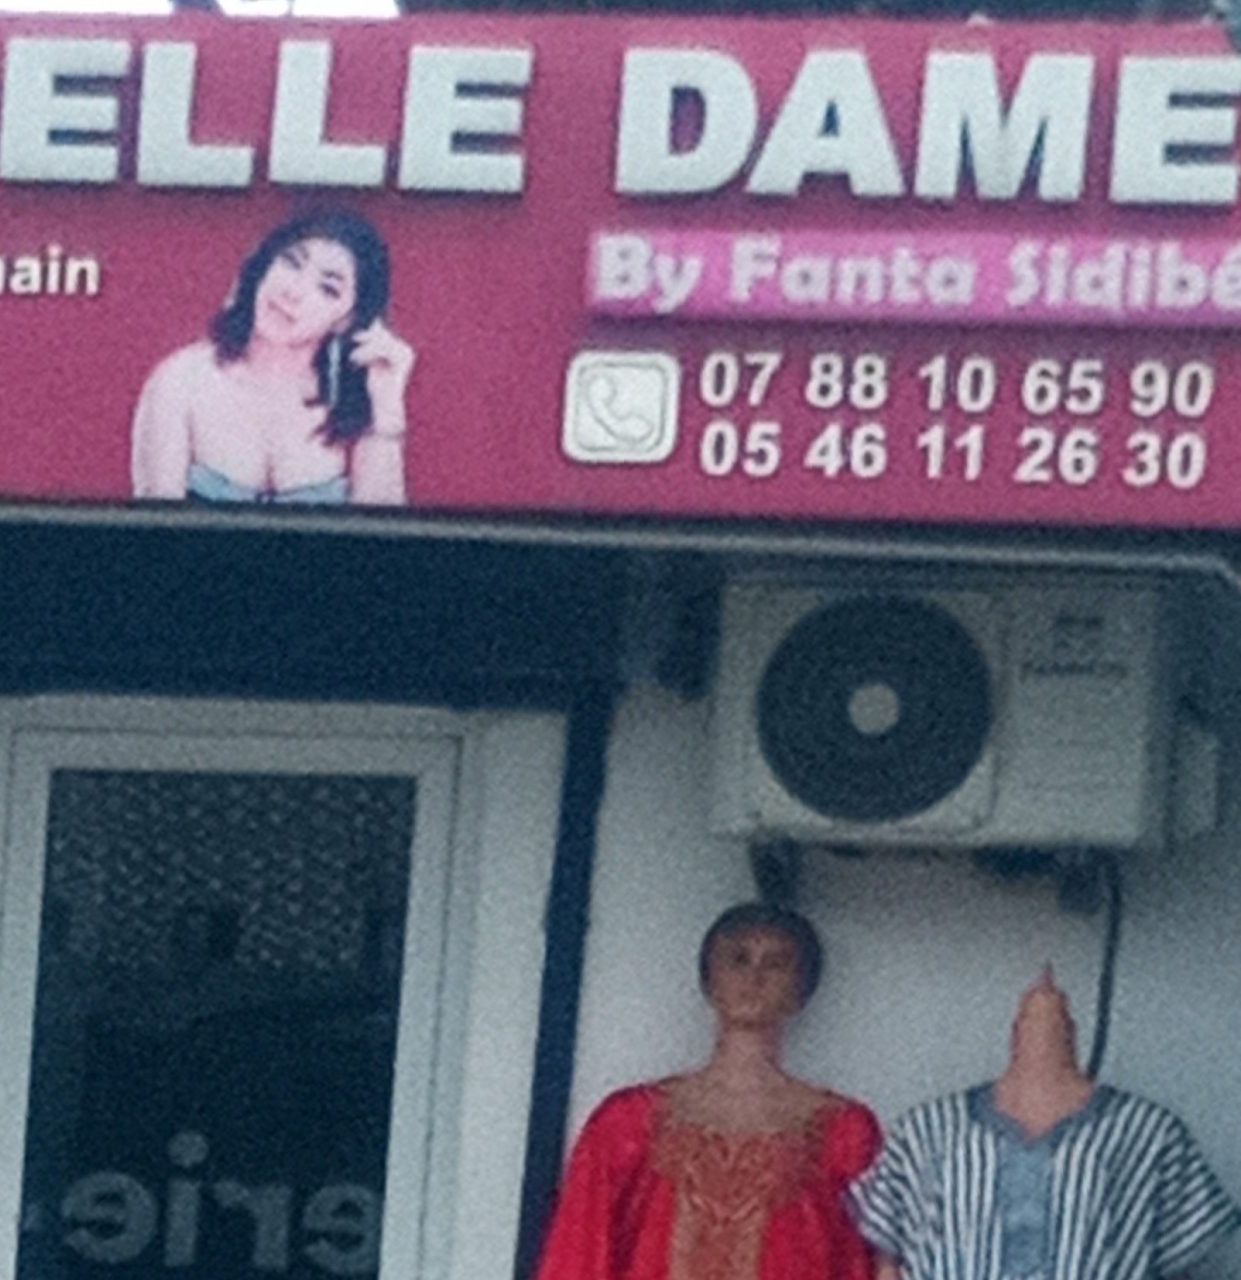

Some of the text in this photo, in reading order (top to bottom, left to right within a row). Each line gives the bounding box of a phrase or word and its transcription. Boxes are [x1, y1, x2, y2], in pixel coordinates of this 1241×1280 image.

[616, 44, 1241, 202] DAME
[594, 233, 704, 312] By
[730, 235, 978, 305] Fanta
[701, 353, 1213, 416] 07 88 10 65 90
[701, 420, 1205, 487] 05 46 11 26 30
